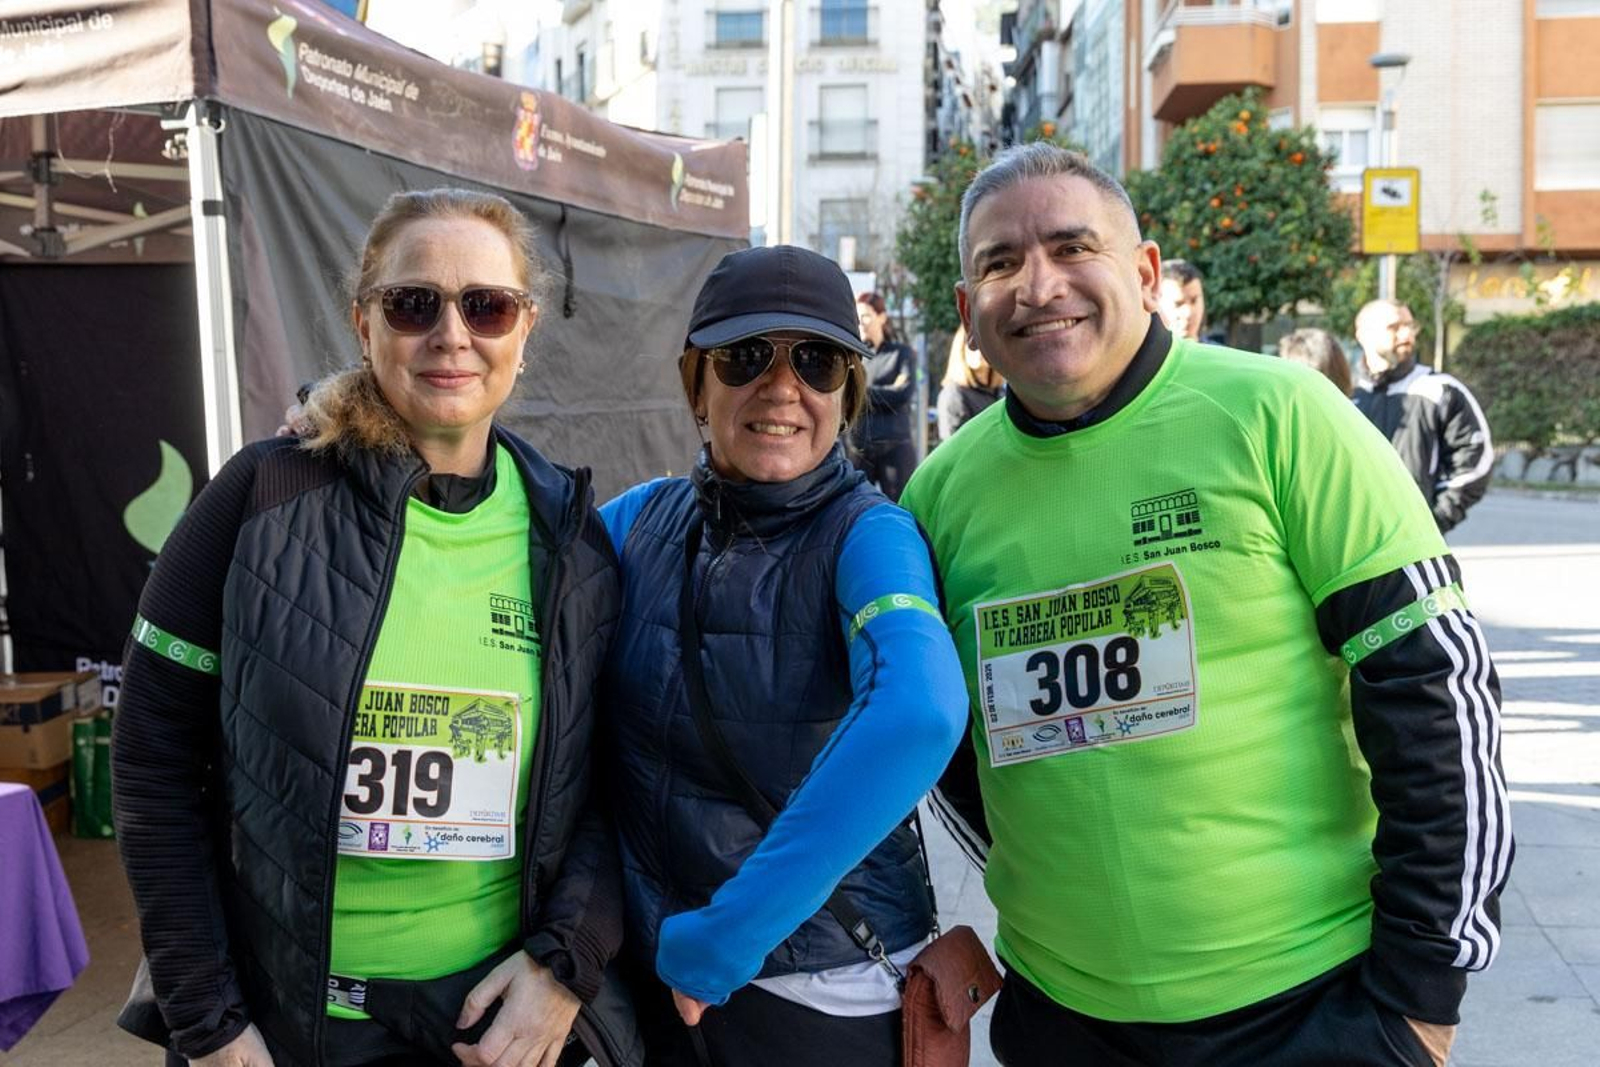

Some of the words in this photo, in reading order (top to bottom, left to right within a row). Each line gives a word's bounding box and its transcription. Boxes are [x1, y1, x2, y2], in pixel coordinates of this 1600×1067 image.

[88, 10, 114, 30] de
[298, 42, 353, 79] Patronato
[353, 62, 406, 96] Municipal
[404, 82, 420, 101] de
[351, 85, 366, 105] de
[1143, 550, 1161, 561] San
[1163, 545, 1188, 556] Juan
[1189, 540, 1221, 552] Bosco
[983, 608, 1013, 630] I.E.S.
[1016, 602, 1041, 625] SAN
[1045, 594, 1078, 619] JUAN
[1083, 584, 1121, 610] BOSCO
[994, 629, 1006, 648] IV
[1008, 619, 1057, 647] CARRERA
[1060, 608, 1113, 638] POPULAR
[499, 640, 515, 651] San
[516, 643, 536, 656] Juan
[1026, 635, 1142, 717] 308
[364, 690, 404, 713] JUAN
[409, 693, 450, 716] BOSCO
[1129, 713, 1153, 723] daño
[1155, 703, 1190, 719] cerebral
[382, 714, 438, 738] POPULAR
[344, 746, 454, 818] 319
[440, 831, 464, 843] daño
[466, 833, 504, 845] cerebral
